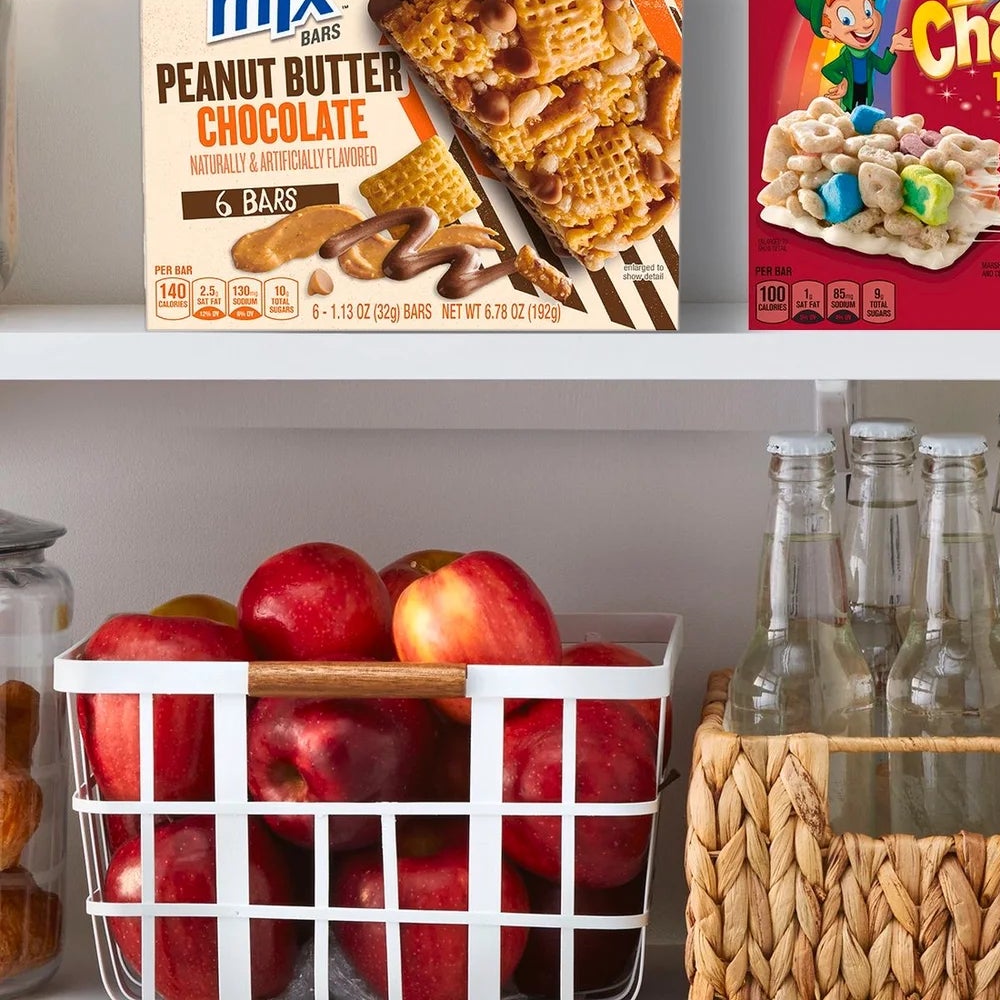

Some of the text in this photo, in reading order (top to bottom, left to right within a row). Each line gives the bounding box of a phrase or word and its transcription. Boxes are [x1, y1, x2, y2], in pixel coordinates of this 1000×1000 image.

[301, 23, 341, 47] BARS
[156, 51, 403, 104] PEANUT BUTTER
[197, 98, 368, 148] CHOCOLATE
[190, 146, 378, 176] NATURALLY & ARTIFICIALLY FLAVORED
[215, 187, 298, 217] 6 BARS
[155, 265, 193, 275] PER BAR
[623, 263, 655, 272] enlarged
[755, 266, 792, 276] PER BAR
[644, 272, 664, 280] detail
[160, 283, 186, 299] 140
[759, 285, 785, 302] 100
[158, 300, 188, 308] CALORIES
[758, 303, 787, 311] CALORIES
[312, 303, 320, 320] 6
[331, 303, 353, 320] 1.13
[356, 303, 371, 320] OZ
[373, 303, 400, 324] (32g)
[403, 303, 432, 320] BARS
[442, 303, 463, 320] NET
[465, 303, 482, 320] WT
[485, 303, 508, 320] 6.78
[511, 303, 525, 320] OZ
[528, 303, 561, 324] (192g)
[866, 309, 891, 317] SUGARS
